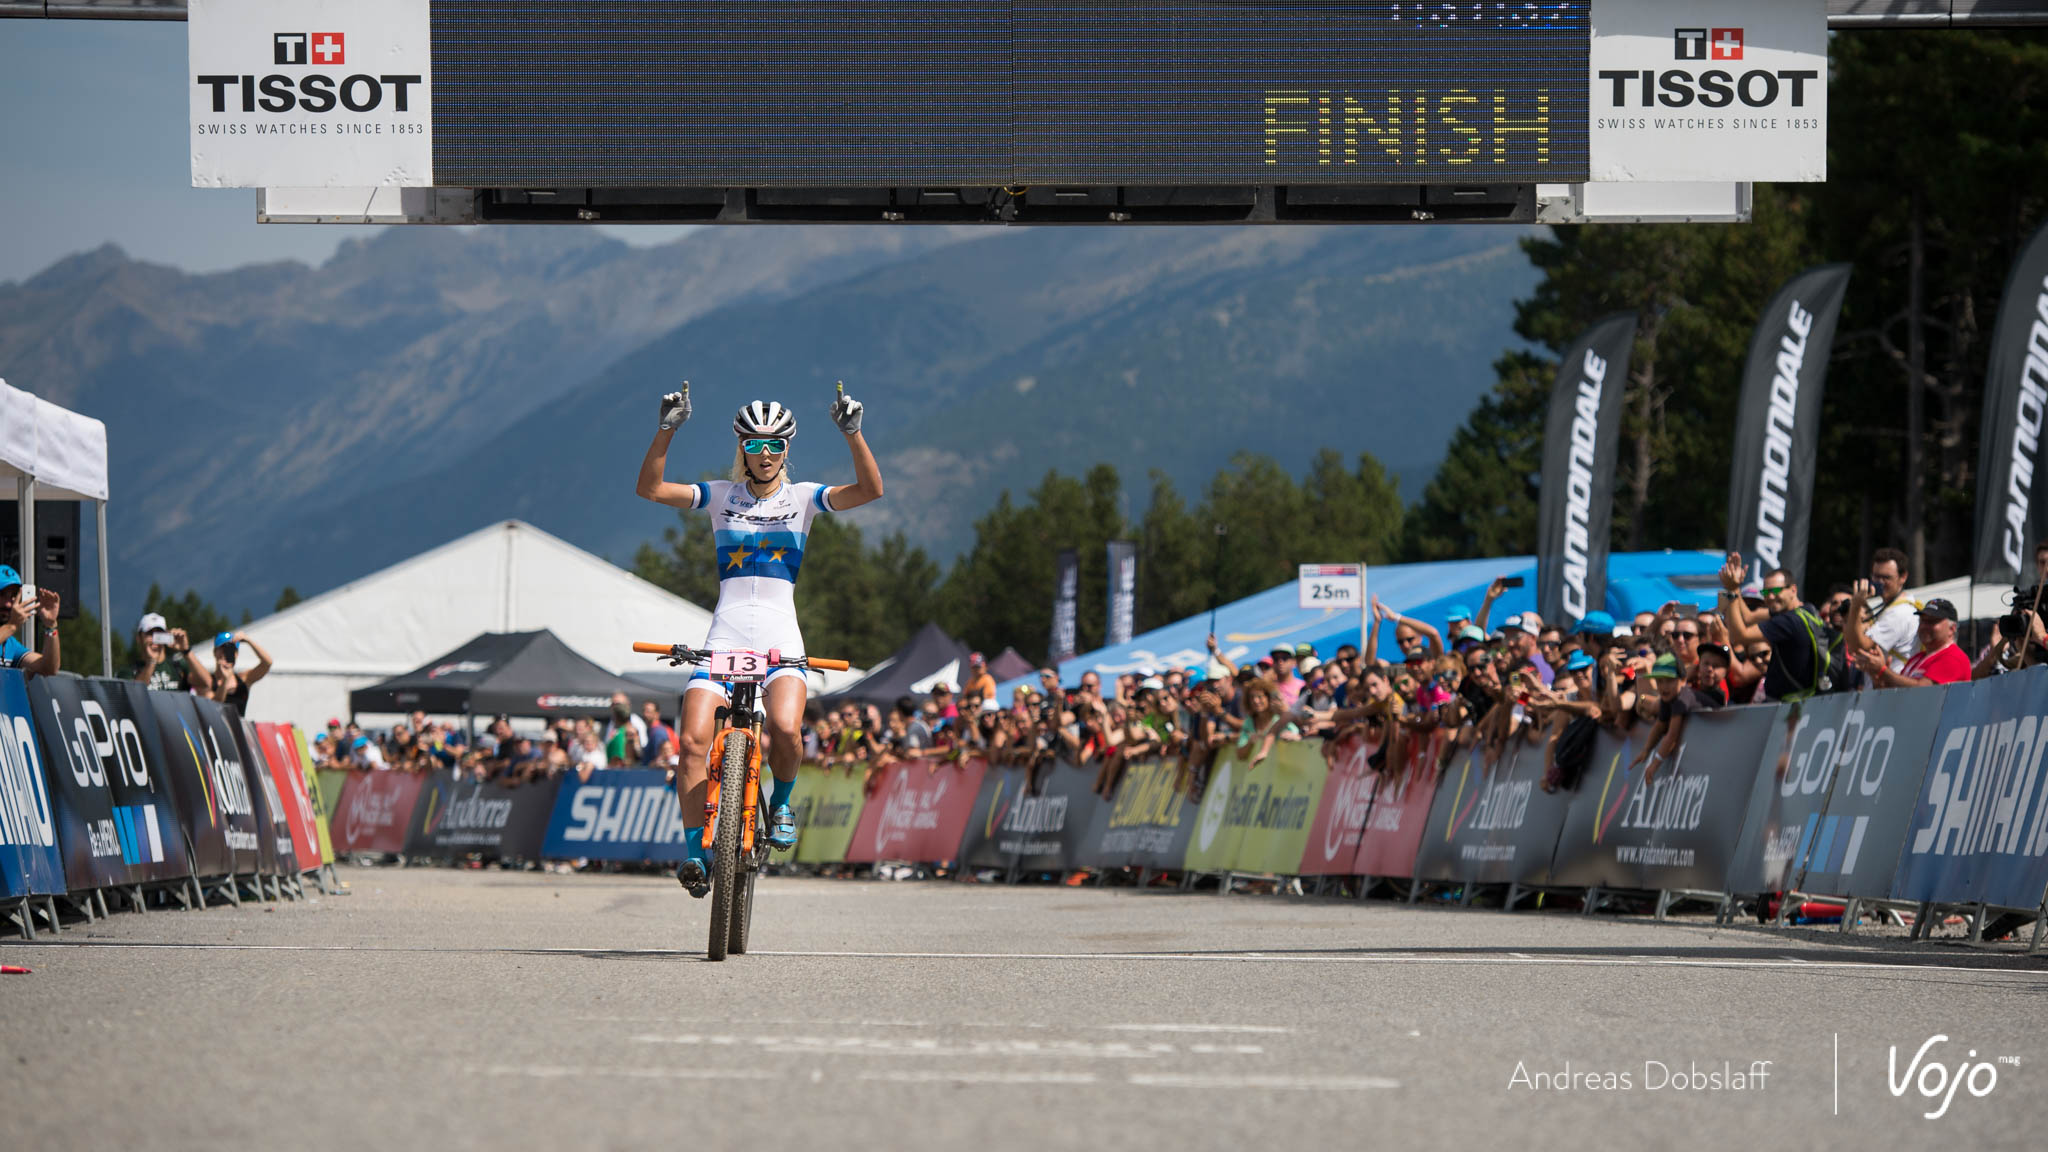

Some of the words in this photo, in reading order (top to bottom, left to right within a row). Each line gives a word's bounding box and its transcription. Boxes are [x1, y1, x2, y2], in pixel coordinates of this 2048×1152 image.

[197, 74, 422, 113] TISSOT
[1598, 69, 1819, 108] TISSOT
[198, 123, 247, 135] SWISS
[255, 123, 328, 135] WATCHES
[336, 123, 382, 135] SINCE
[391, 123, 424, 135] 1853
[1264, 89, 1549, 165] FINISH
[1597, 118, 1646, 130] SWISS
[1654, 118, 1725, 130] WATCHES
[1733, 118, 1778, 129] SINCE
[1786, 118, 1819, 129] 1853
[1312, 584, 1350, 600] 25m
[727, 656, 757, 672] 13
[52, 698, 148, 787] GoPro
[1780, 709, 1896, 798] GoPro
[1620, 742, 1711, 832] Andorra
